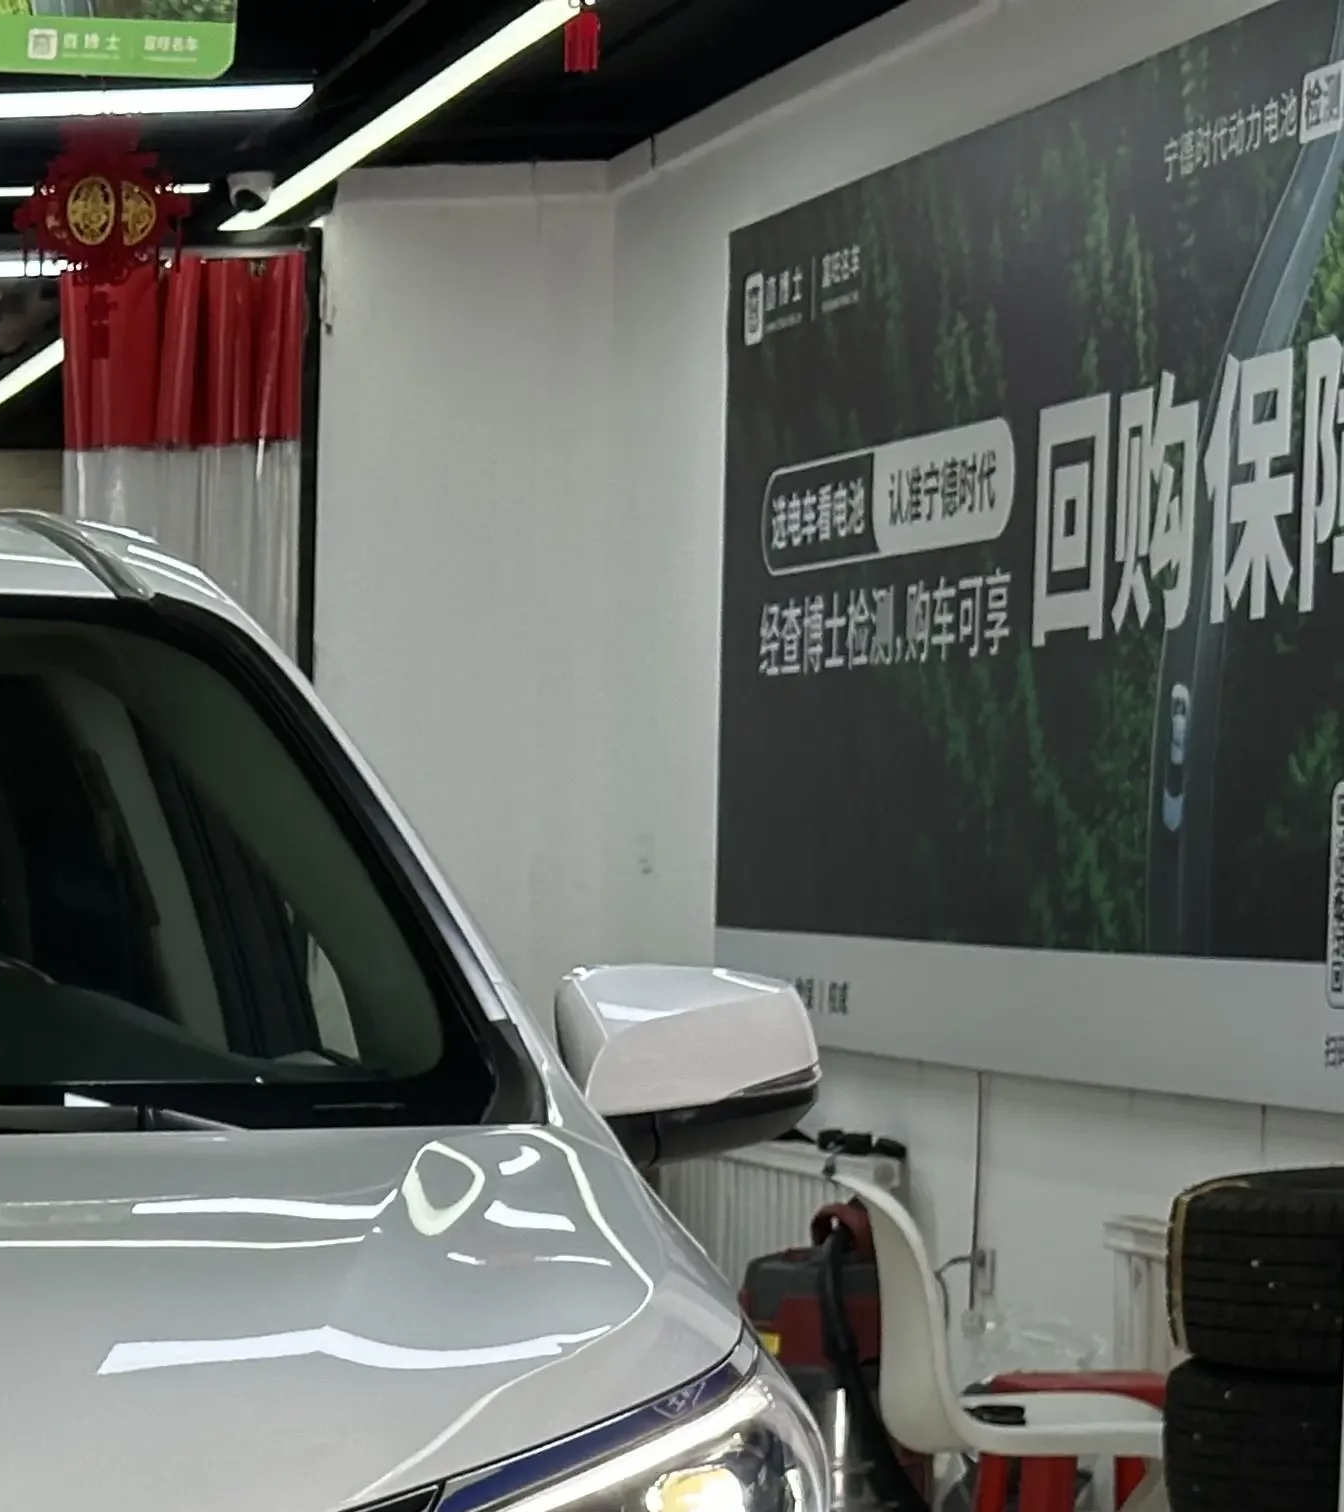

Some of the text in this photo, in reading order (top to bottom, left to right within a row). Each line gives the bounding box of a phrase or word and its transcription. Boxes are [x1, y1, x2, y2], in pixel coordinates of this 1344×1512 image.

[888, 450, 997, 526] 认准宁德时代
